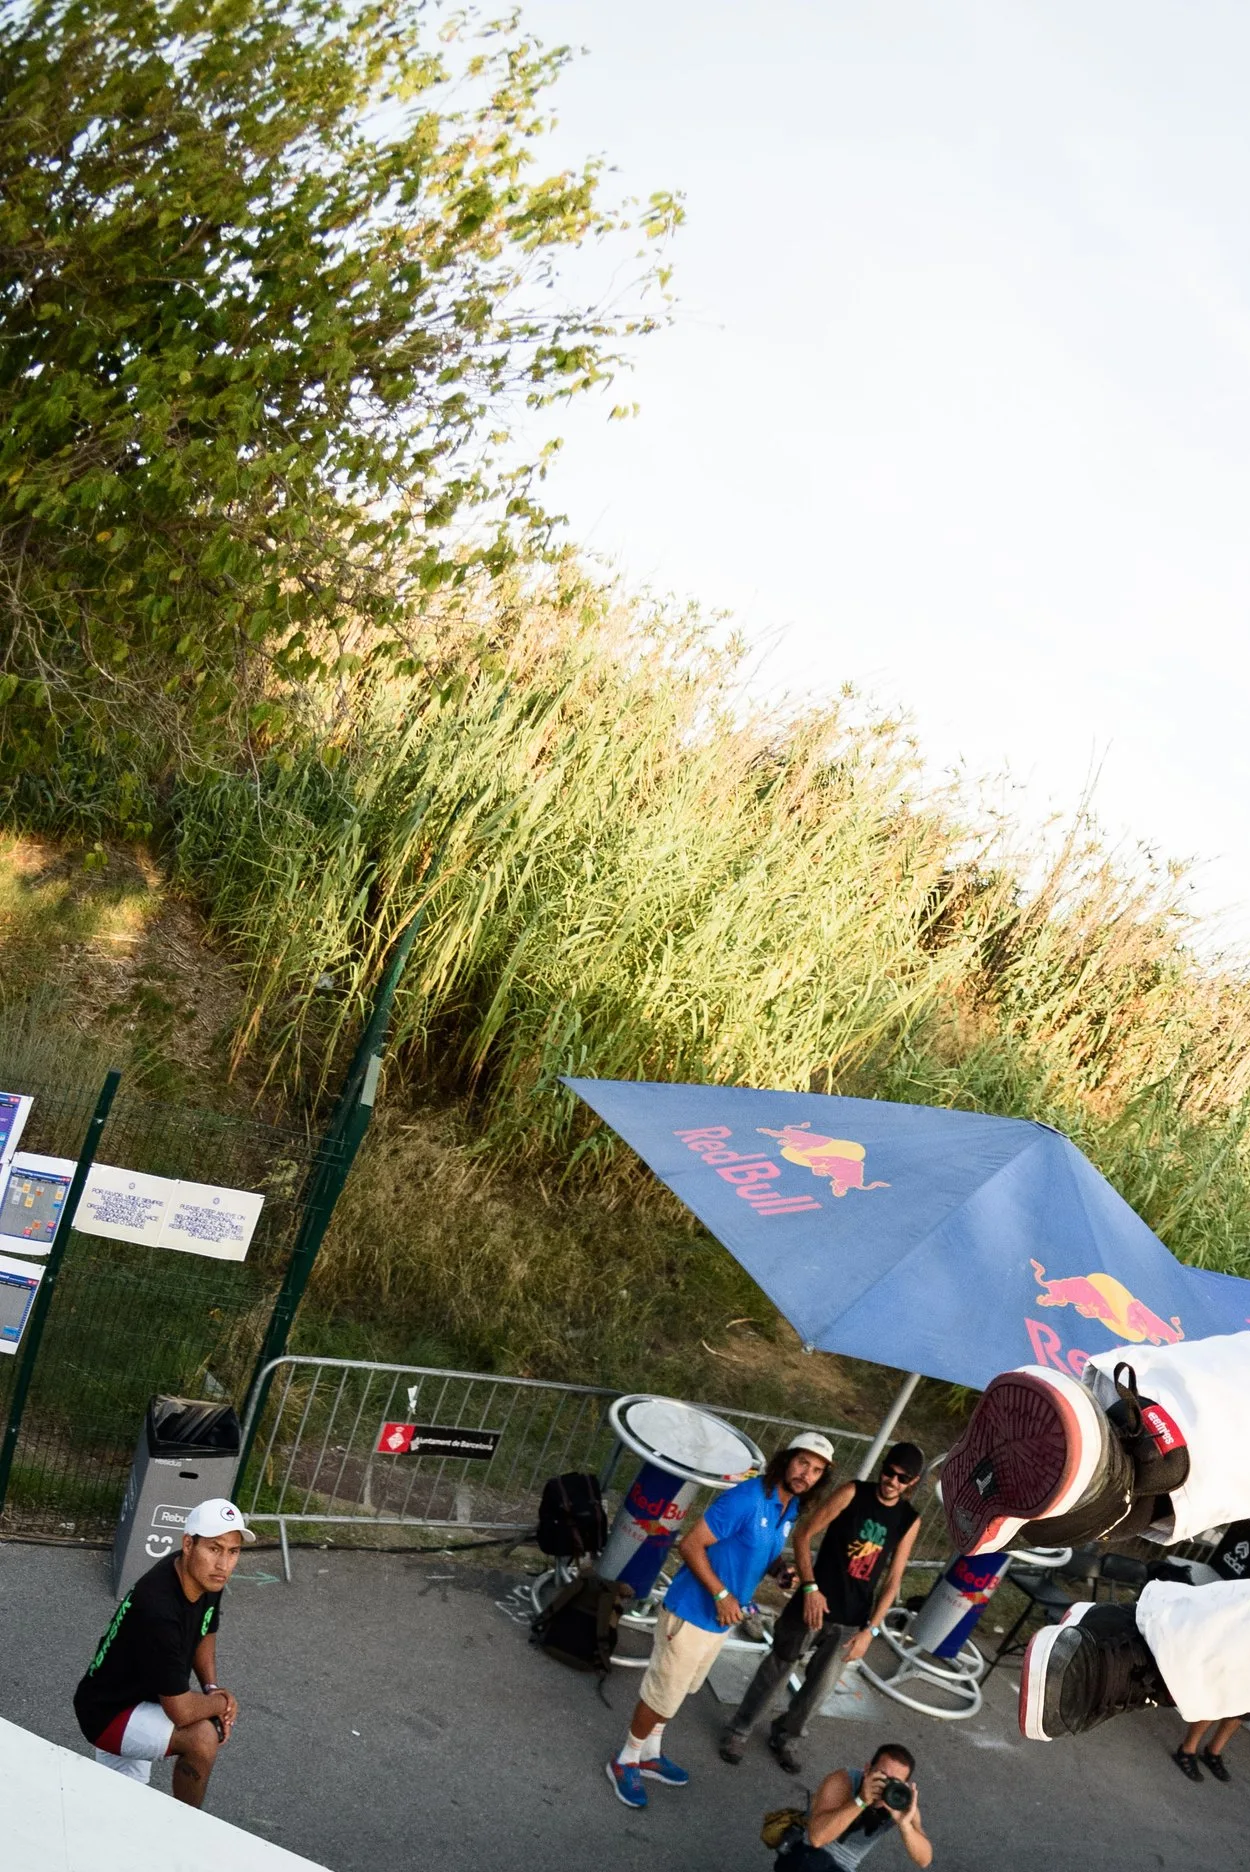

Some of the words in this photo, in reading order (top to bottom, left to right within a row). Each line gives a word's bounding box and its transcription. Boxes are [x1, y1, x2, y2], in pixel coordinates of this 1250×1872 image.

[673, 1126, 766, 1165] Red
[716, 1160, 822, 1216] Bull
[1024, 1317, 1091, 1376] Re
[461, 1441, 493, 1450] Barcelona
[161, 1511, 187, 1524] Rebu
[630, 1482, 664, 1515] Red
[663, 1501, 687, 1521] Bu
[955, 1560, 988, 1589] Red
